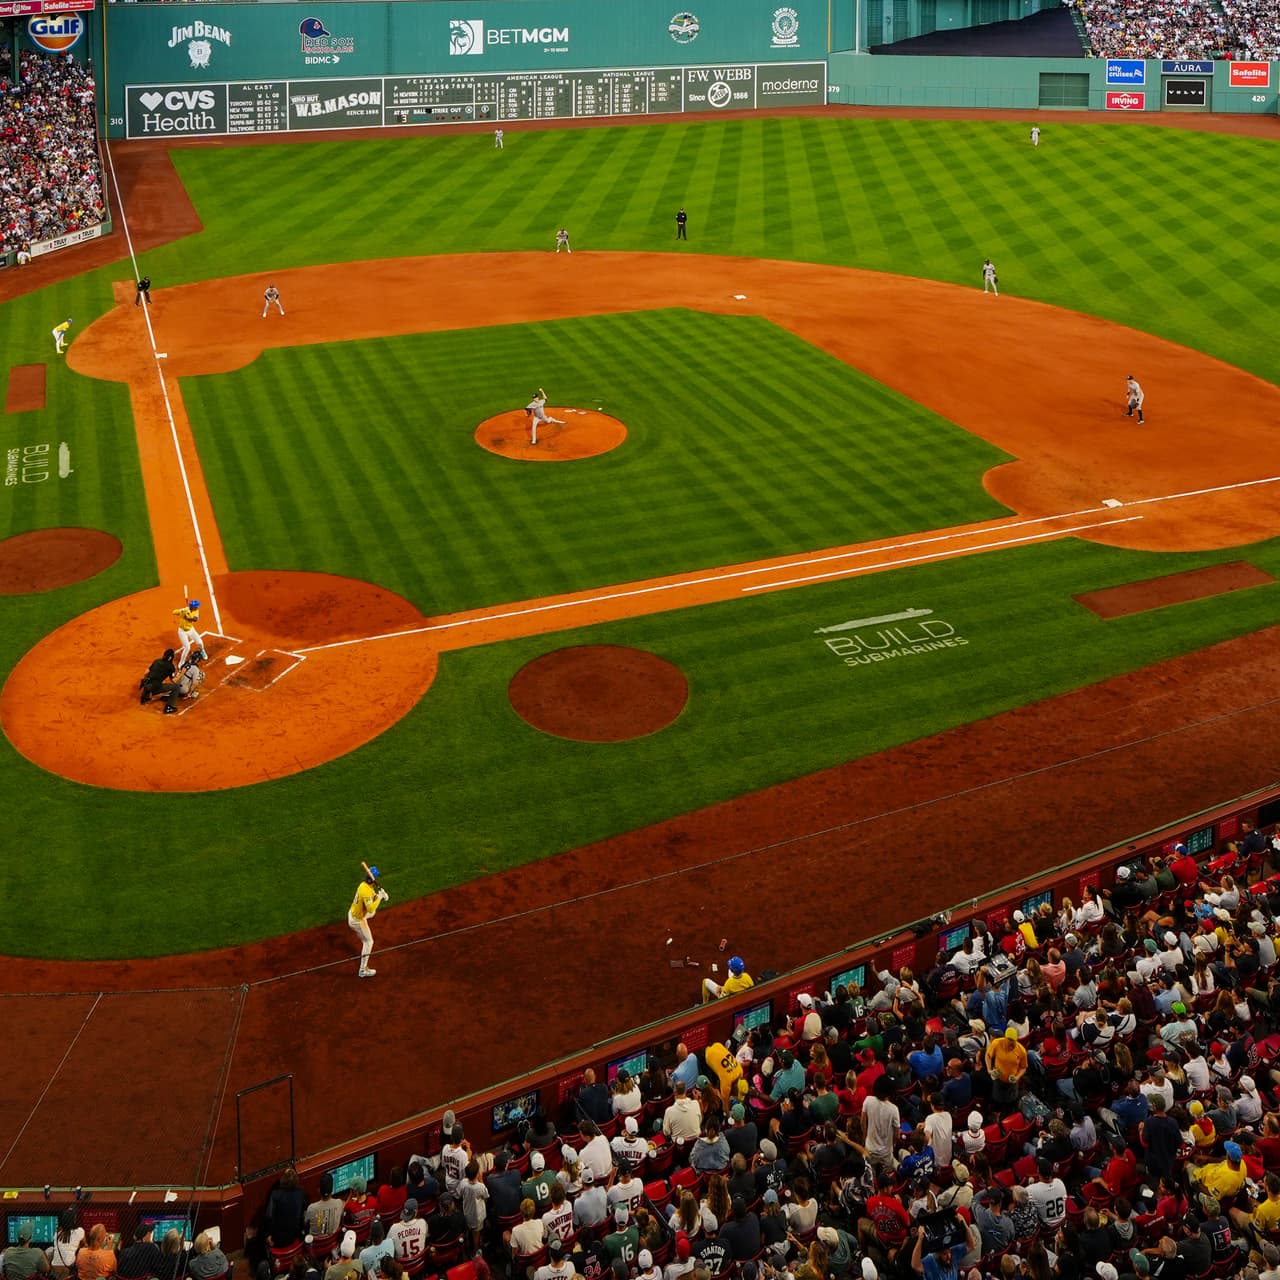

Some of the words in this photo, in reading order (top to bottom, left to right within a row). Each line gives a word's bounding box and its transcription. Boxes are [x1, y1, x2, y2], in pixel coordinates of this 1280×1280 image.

[44, 3, 69, 11] Safelite
[30, 19, 80, 35] Gulf
[168, 26, 193, 48] JIM
[194, 20, 232, 47] BEAM
[305, 38, 328, 46] RED
[487, 27, 569, 45] BETMGM
[305, 56, 331, 64] BIDMC
[713, 69, 752, 81] WEBB
[762, 78, 818, 91] moderna
[164, 90, 215, 111] CVS
[296, 92, 381, 117] W.B.MASON
[689, 94, 705, 102] Since
[1111, 97, 1138, 105] IRVING
[110, 118, 123, 126] 310
[143, 112, 216, 132] Health
[5, 448, 20, 487] SUBMARINES
[22, 443, 50, 484] BUILD
[824, 620, 955, 656] BUILD
[844, 636, 969, 667] SUBMARINES
[854, 1006, 863, 1018] 16
[536, 1182, 549, 1201] 19
[1046, 1198, 1064, 1217] 26
[397, 1228, 421, 1239] PEDROIA
[401, 1240, 419, 1258] 15
[621, 1244, 634, 1260] 16
[700, 1246, 725, 1258] STANTON
